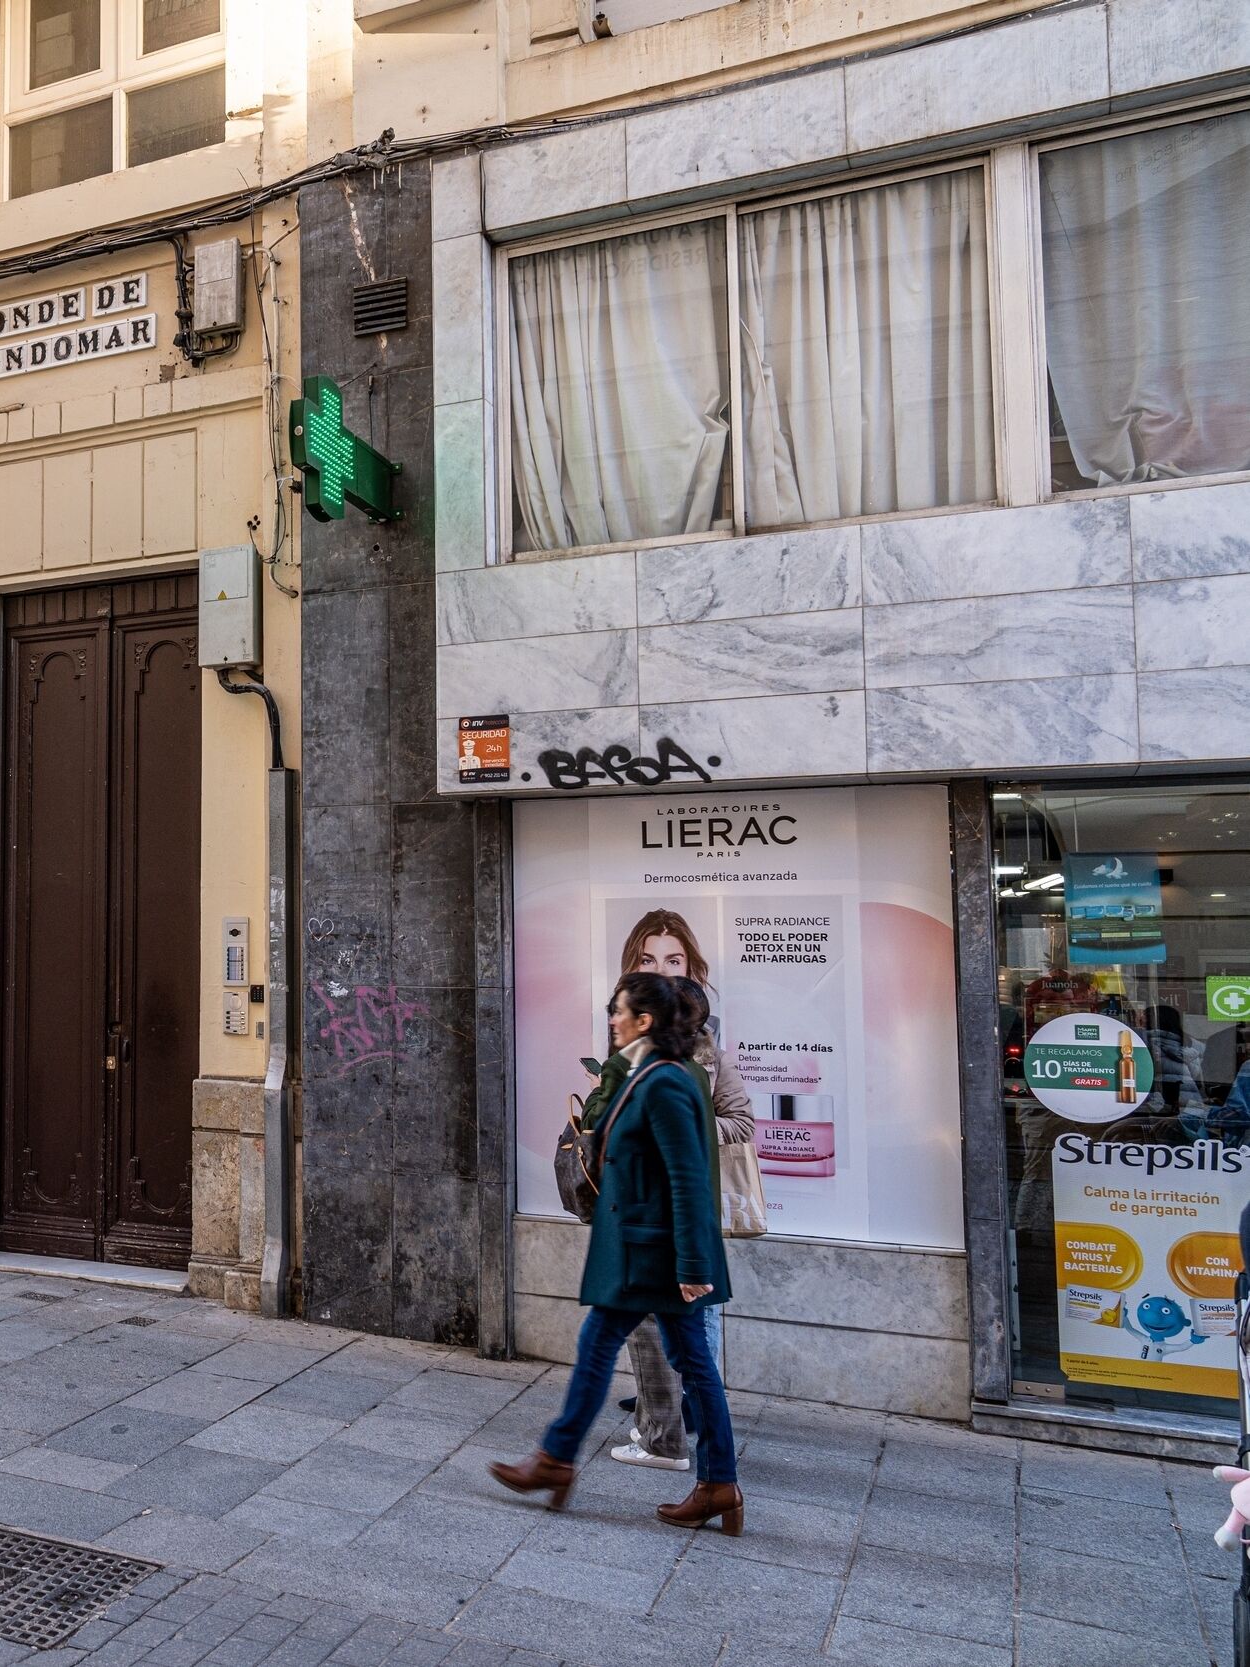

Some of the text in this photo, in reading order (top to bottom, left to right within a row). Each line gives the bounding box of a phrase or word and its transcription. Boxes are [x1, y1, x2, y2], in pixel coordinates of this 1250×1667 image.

[97, 278, 141, 310] DE
[462, 730, 506, 740] SEGURIDAD
[657, 804, 781, 815] LABORATOIRES
[641, 815, 798, 849] LIERAC
[696, 850, 741, 858] PARIS
[644, 870, 798, 884] Dermocosmética avanzada
[735, 917, 830, 926] SUPRA RADIANCE
[738, 933, 828, 941] TODO EL PODER
[745, 944, 821, 952] DETOX EN UN
[740, 955, 827, 963] ANTI-ARRUGAS
[738, 1041, 834, 1053] A partir de 14 días
[1048, 1048, 1103, 1057] REGALAMOS
[738, 1054, 761, 1062] Detox
[738, 1065, 788, 1073] Luminosidad
[1031, 1059, 1061, 1078] 10
[1063, 1066, 1116, 1074] TRATAMIENTO
[1075, 1078, 1102, 1086] GRATIS
[765, 1129, 811, 1142] LIERAC
[1084, 1185, 1220, 1205] Calma la irritación
[1110, 1201, 1198, 1217] de garganta
[1066, 1240, 1117, 1252] COMBATE
[1071, 1251, 1113, 1262] VIRUS Y
[1205, 1256, 1229, 1266] CON
[1064, 1261, 1123, 1274] BACTERIAS
[1185, 1265, 1240, 1278] VITAMINA
[1069, 1288, 1102, 1301] Strepsils
[1199, 1303, 1235, 1312] Strepsils
